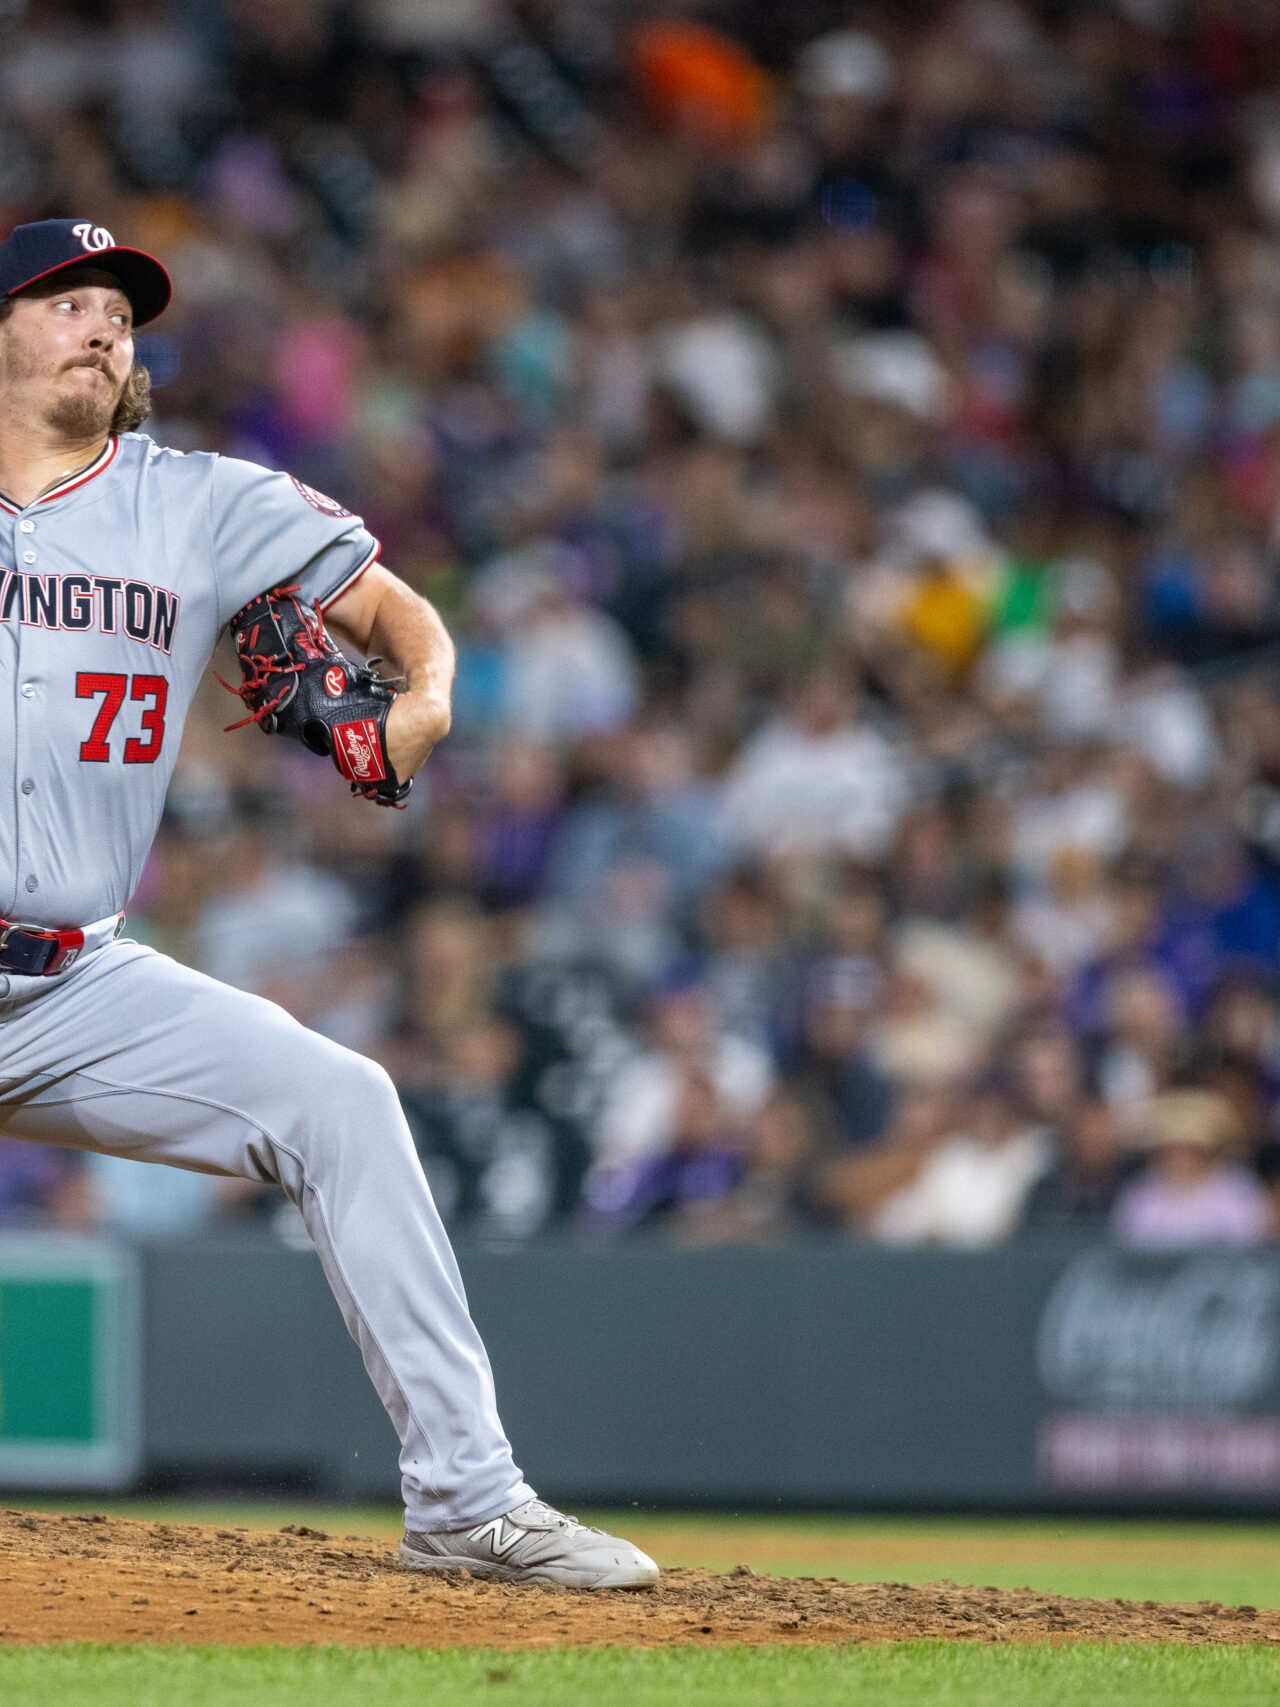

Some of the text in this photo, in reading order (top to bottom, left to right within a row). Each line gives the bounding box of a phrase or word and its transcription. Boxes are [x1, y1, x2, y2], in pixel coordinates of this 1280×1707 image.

[72, 223, 116, 252] W
[75, 671, 169, 764] 73
[346, 727, 371, 777] Rawlings
[60, 948, 79, 968] 73
